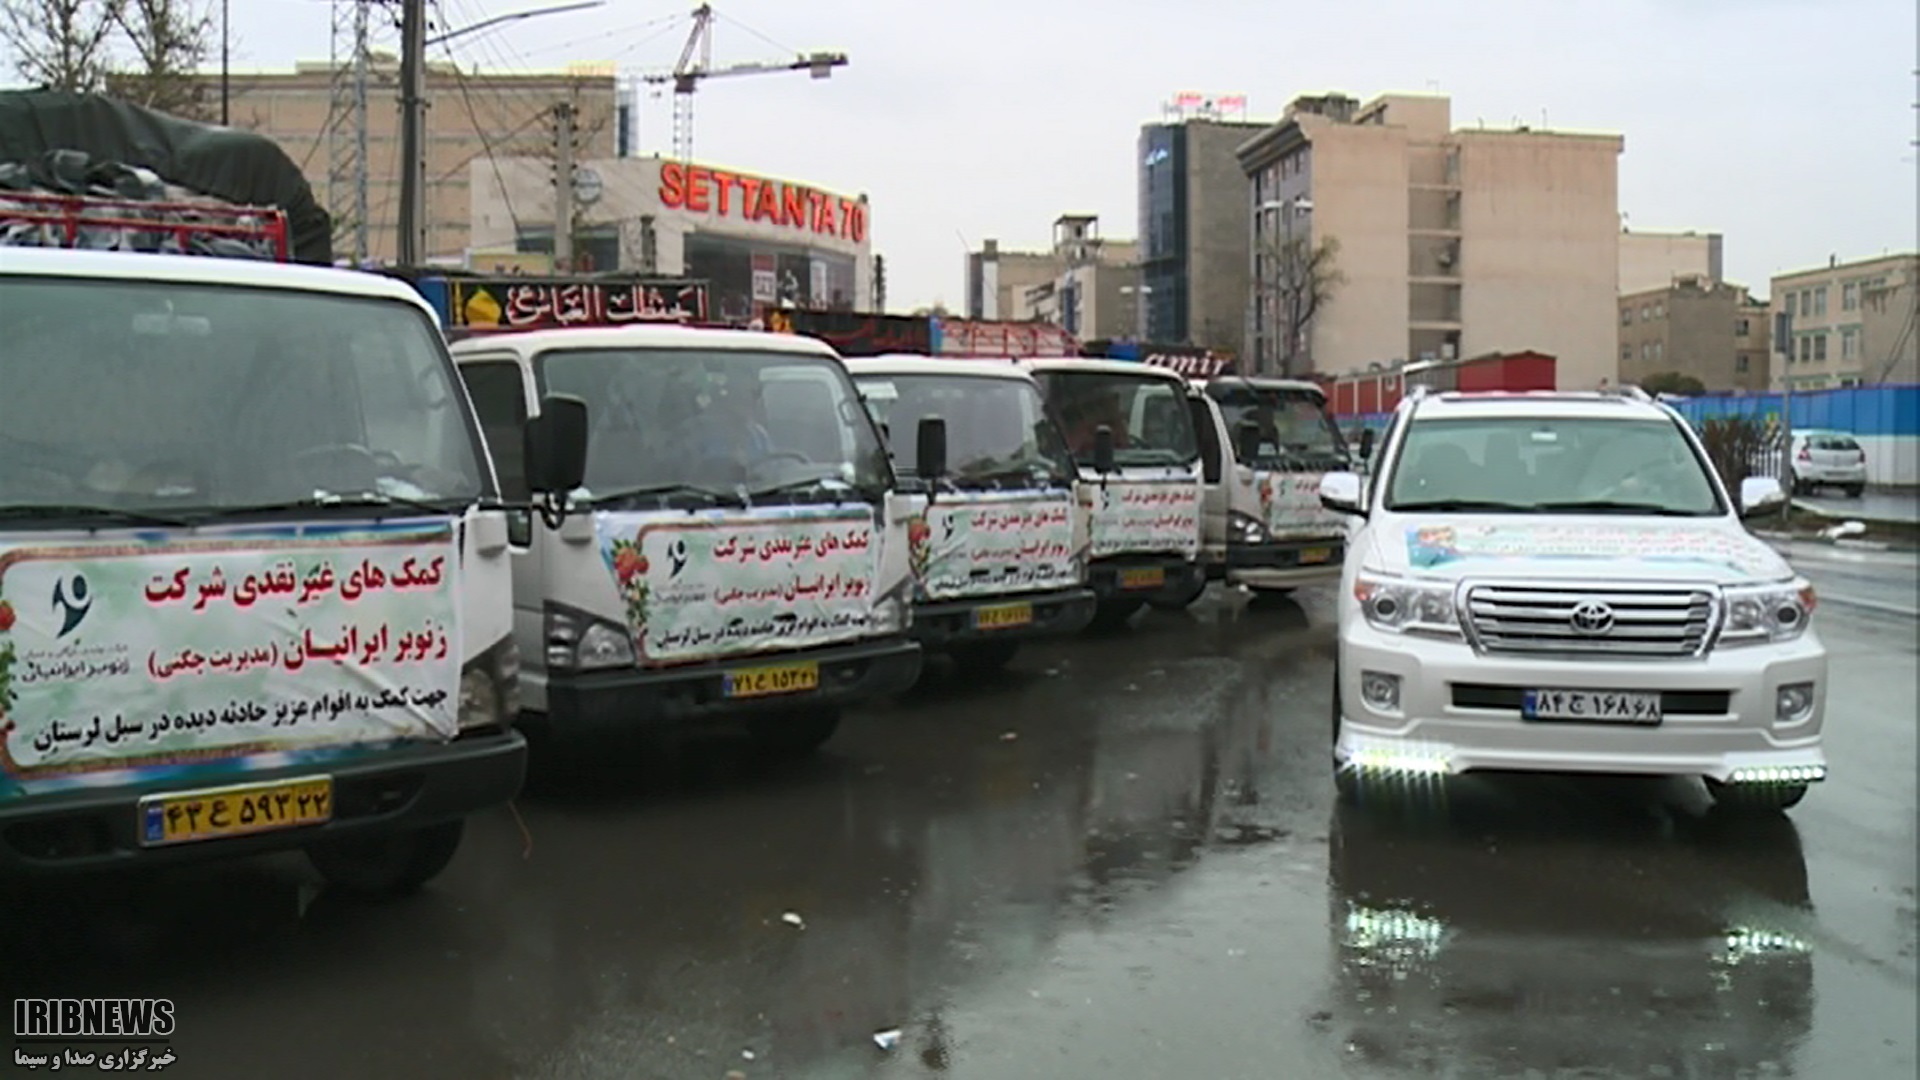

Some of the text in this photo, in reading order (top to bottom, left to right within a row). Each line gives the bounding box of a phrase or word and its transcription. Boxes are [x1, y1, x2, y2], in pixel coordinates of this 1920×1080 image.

[660, 163, 864, 243] SETTANTA 70
[145, 556, 444, 610] کمک های غیر نقدی شرکت
[284, 623, 388, 670] ایرانیان
[395, 620, 447, 662] زنوبر
[311, 688, 351, 722] اقوام
[354, 694, 370, 717] به
[372, 686, 409, 710] کمک
[411, 688, 447, 711] جهت
[149, 713, 171, 740] در
[174, 708, 217, 735] دیده
[220, 700, 268, 725] حادثه
[272, 699, 309, 727] عزیز
[34, 715, 101, 753] لرستان
